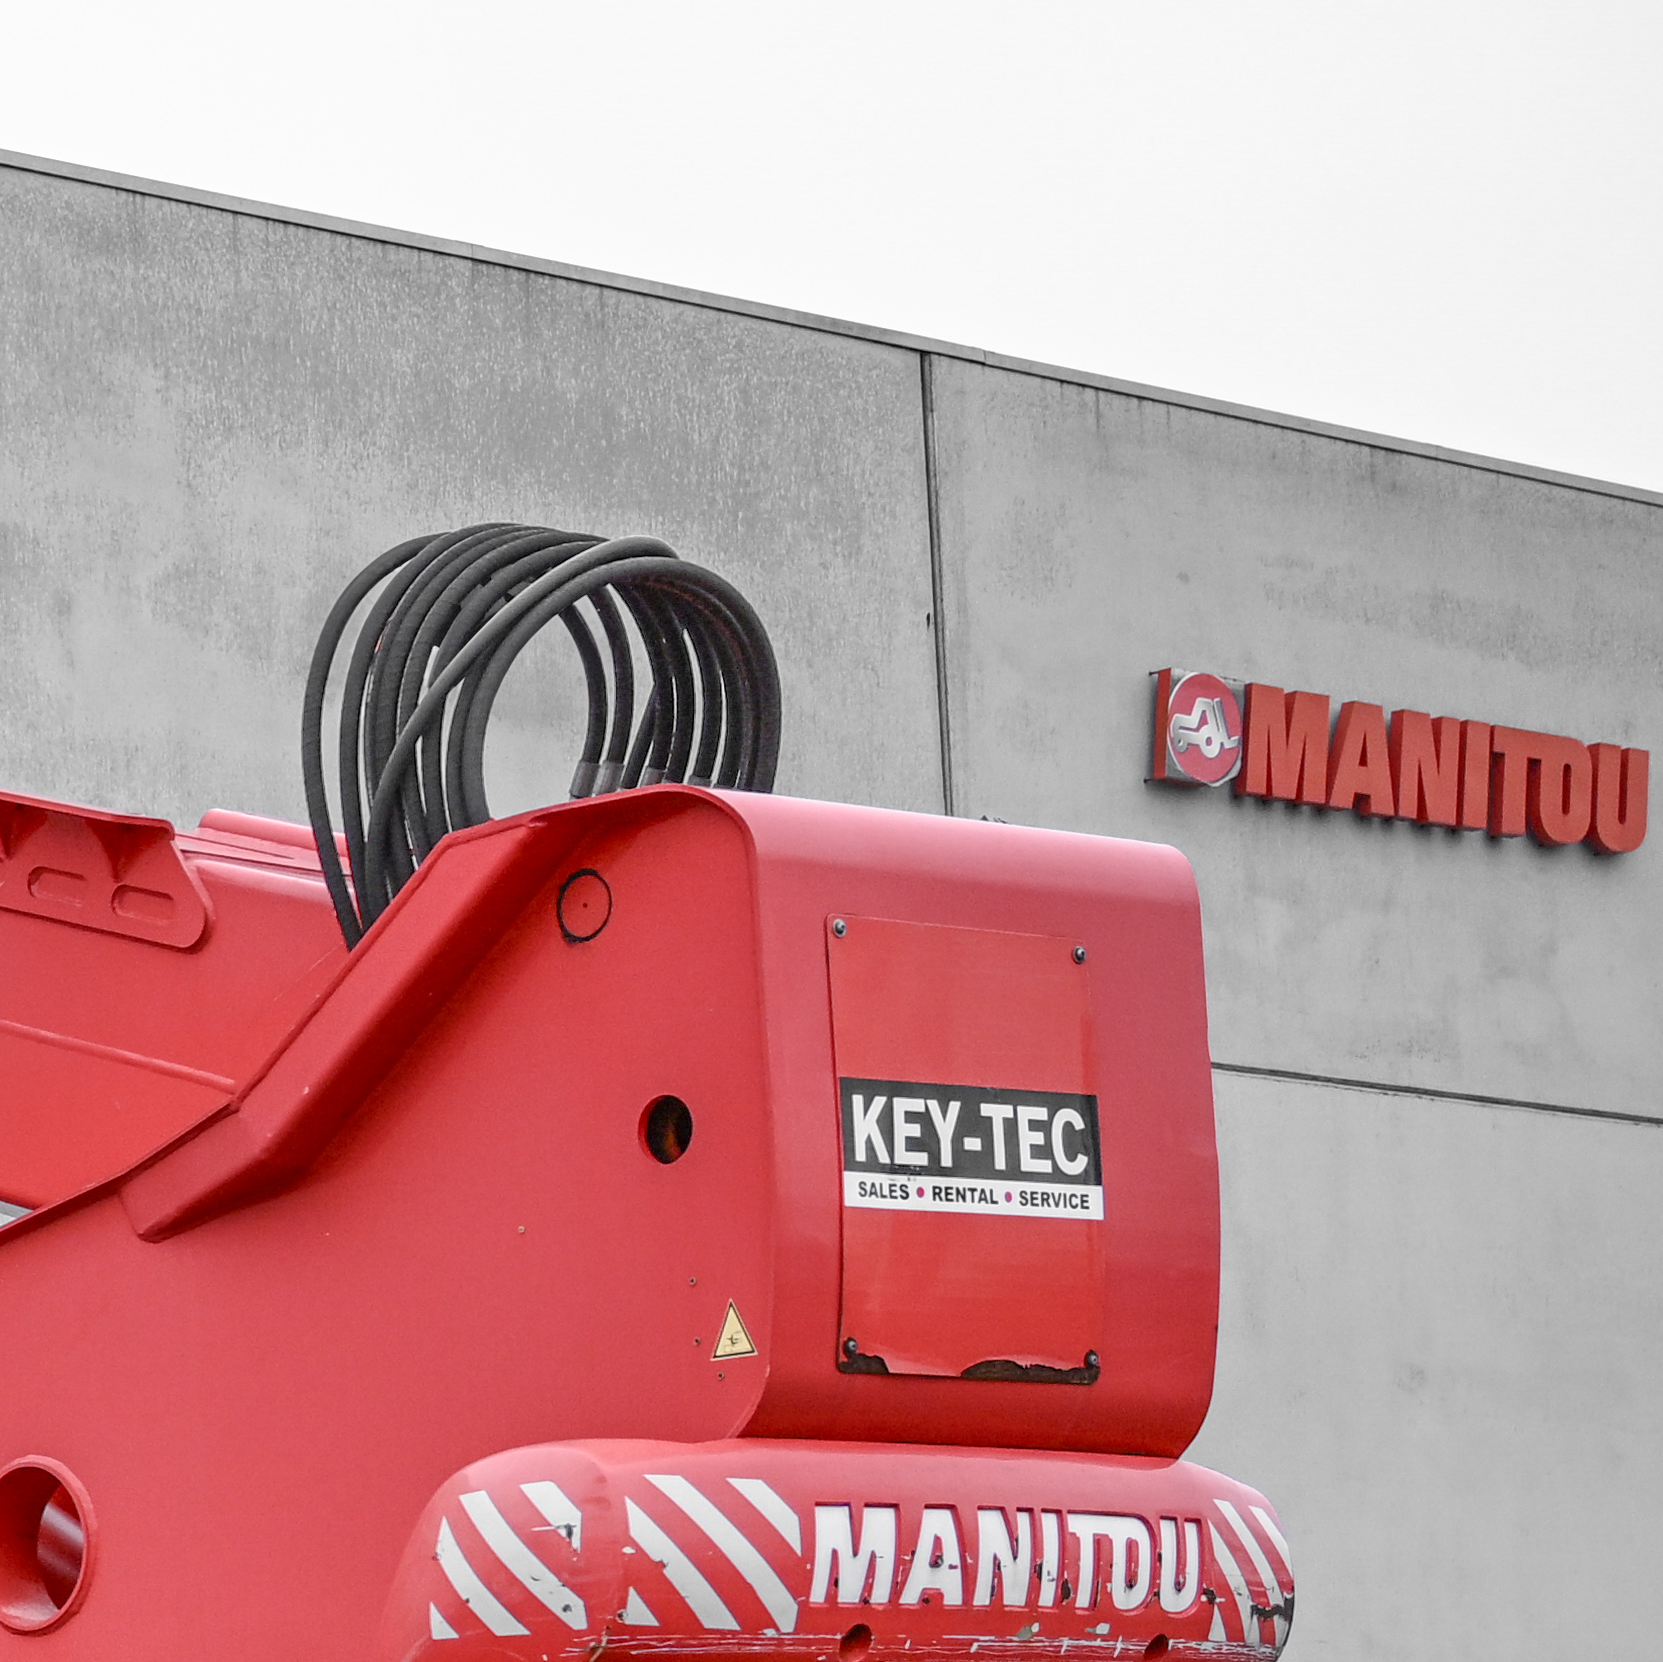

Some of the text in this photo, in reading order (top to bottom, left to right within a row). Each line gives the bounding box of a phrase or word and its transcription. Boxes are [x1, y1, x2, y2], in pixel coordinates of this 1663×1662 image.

[1235, 682, 1650, 855] MANITOU
[851, 1094, 1089, 1176] KEY-TEC
[858, 1181, 1090, 1210] SALES RENTAL SERVICE
[809, 1503, 1205, 1613] MANITOU
